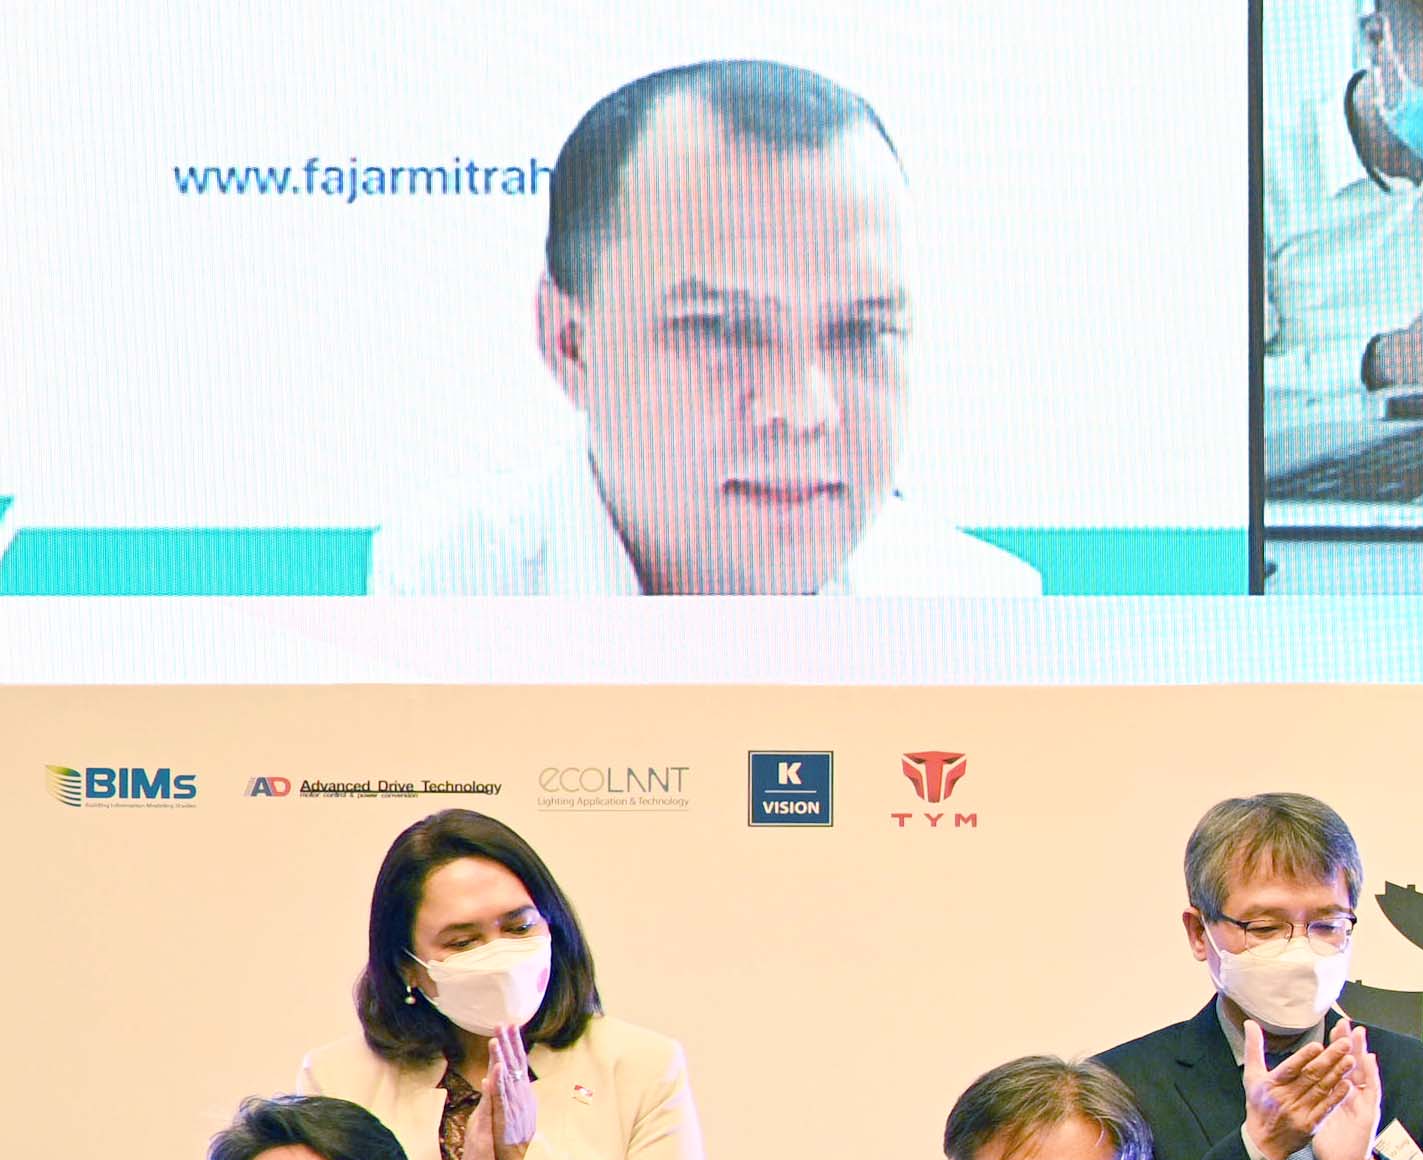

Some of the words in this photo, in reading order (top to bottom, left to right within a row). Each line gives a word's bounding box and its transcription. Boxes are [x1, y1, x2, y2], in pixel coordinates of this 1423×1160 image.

[174, 157, 553, 204] www.fajarmitrah
[777, 761, 802, 785] K
[85, 767, 197, 800] BIMs
[300, 780, 370, 793] Advanced
[378, 780, 414, 793] Drive
[421, 780, 502, 795] Technology
[537, 797, 575, 807] Lighting
[577, 797, 628, 807] Application
[638, 797, 689, 807] Technology
[762, 801, 820, 815] VISION
[890, 812, 978, 828] TYM
